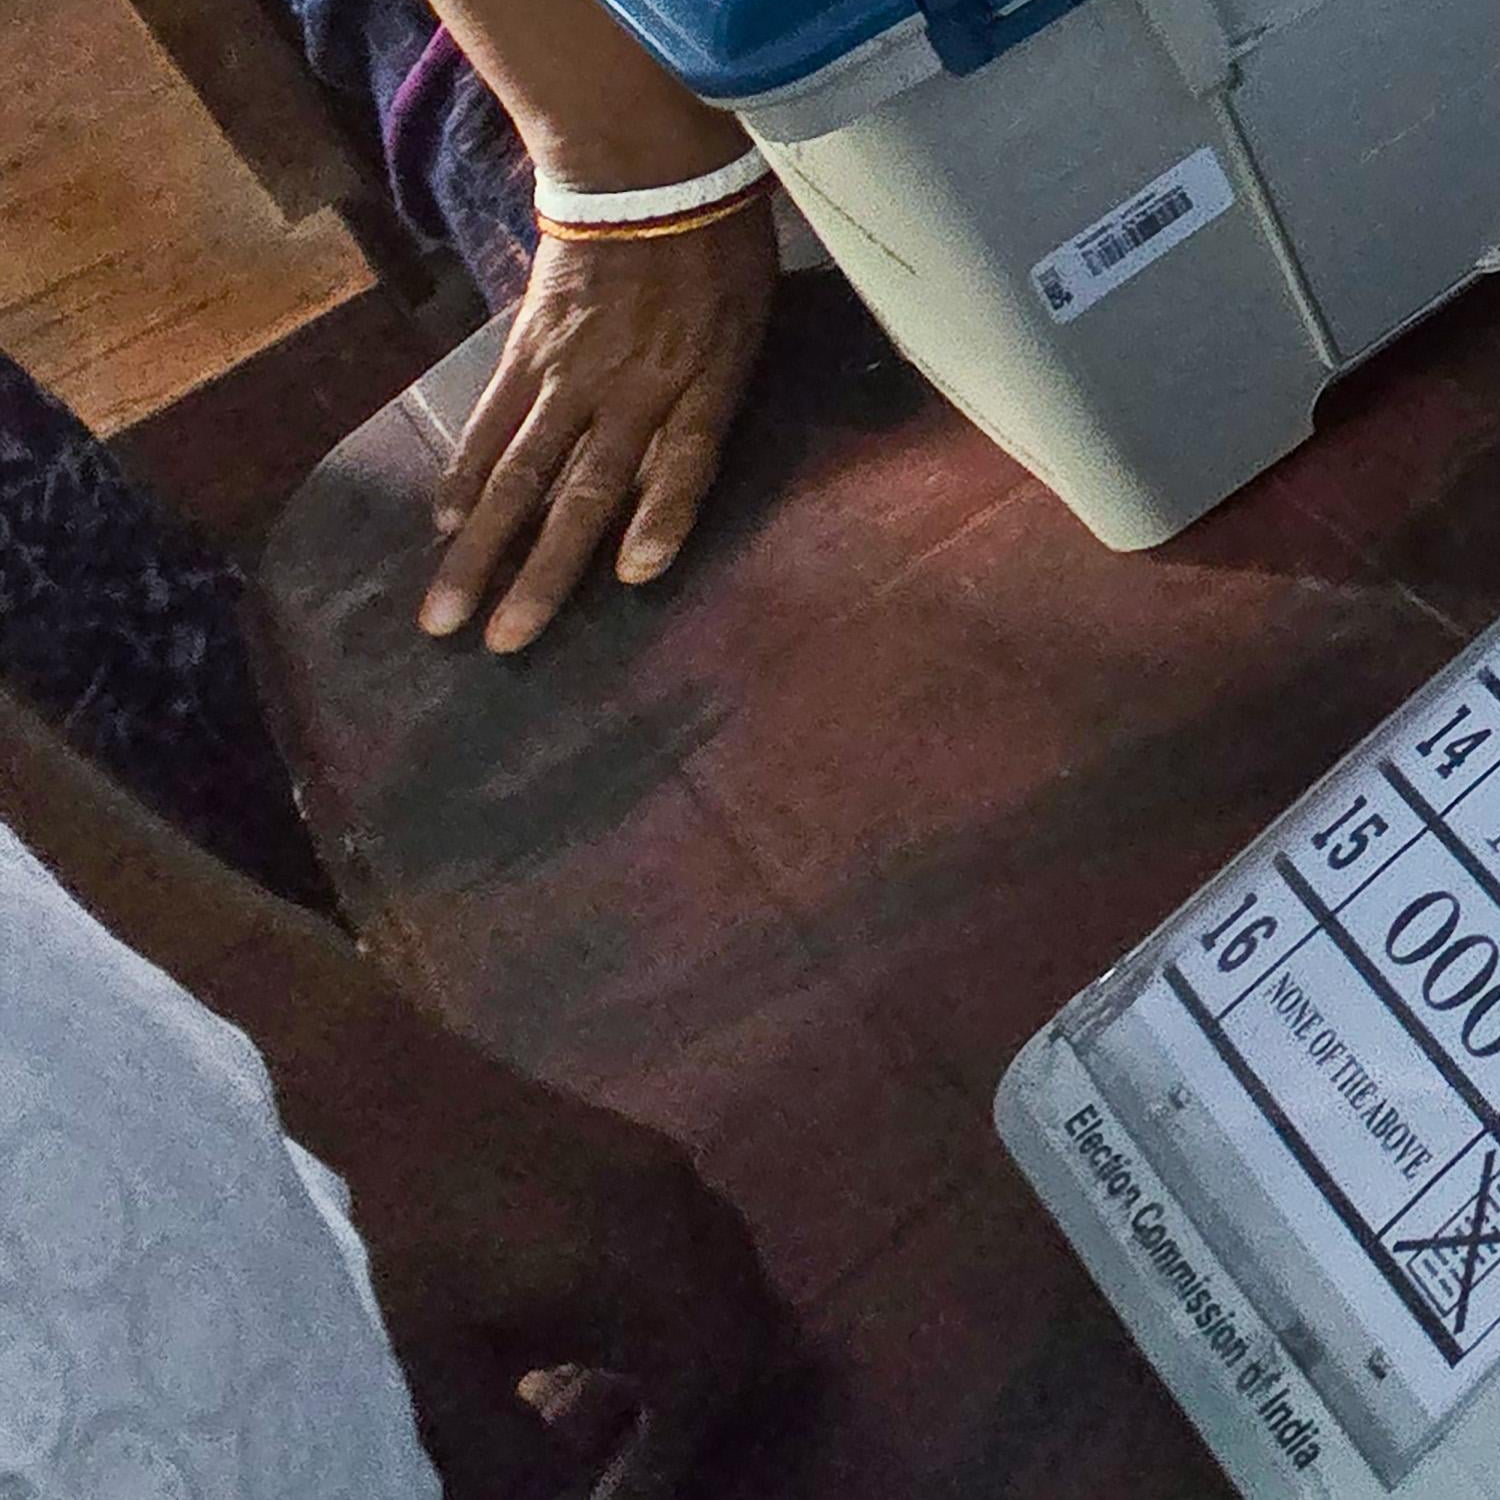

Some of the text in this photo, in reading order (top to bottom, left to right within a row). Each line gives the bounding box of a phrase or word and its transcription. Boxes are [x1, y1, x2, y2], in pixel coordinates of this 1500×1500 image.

[1416, 704, 1492, 779] 14
[1311, 795, 1388, 870] 15
[1200, 892, 1434, 1180] 16 NONE OF THE ABOVE
[1064, 1103, 1323, 1469] Election Commission of India
